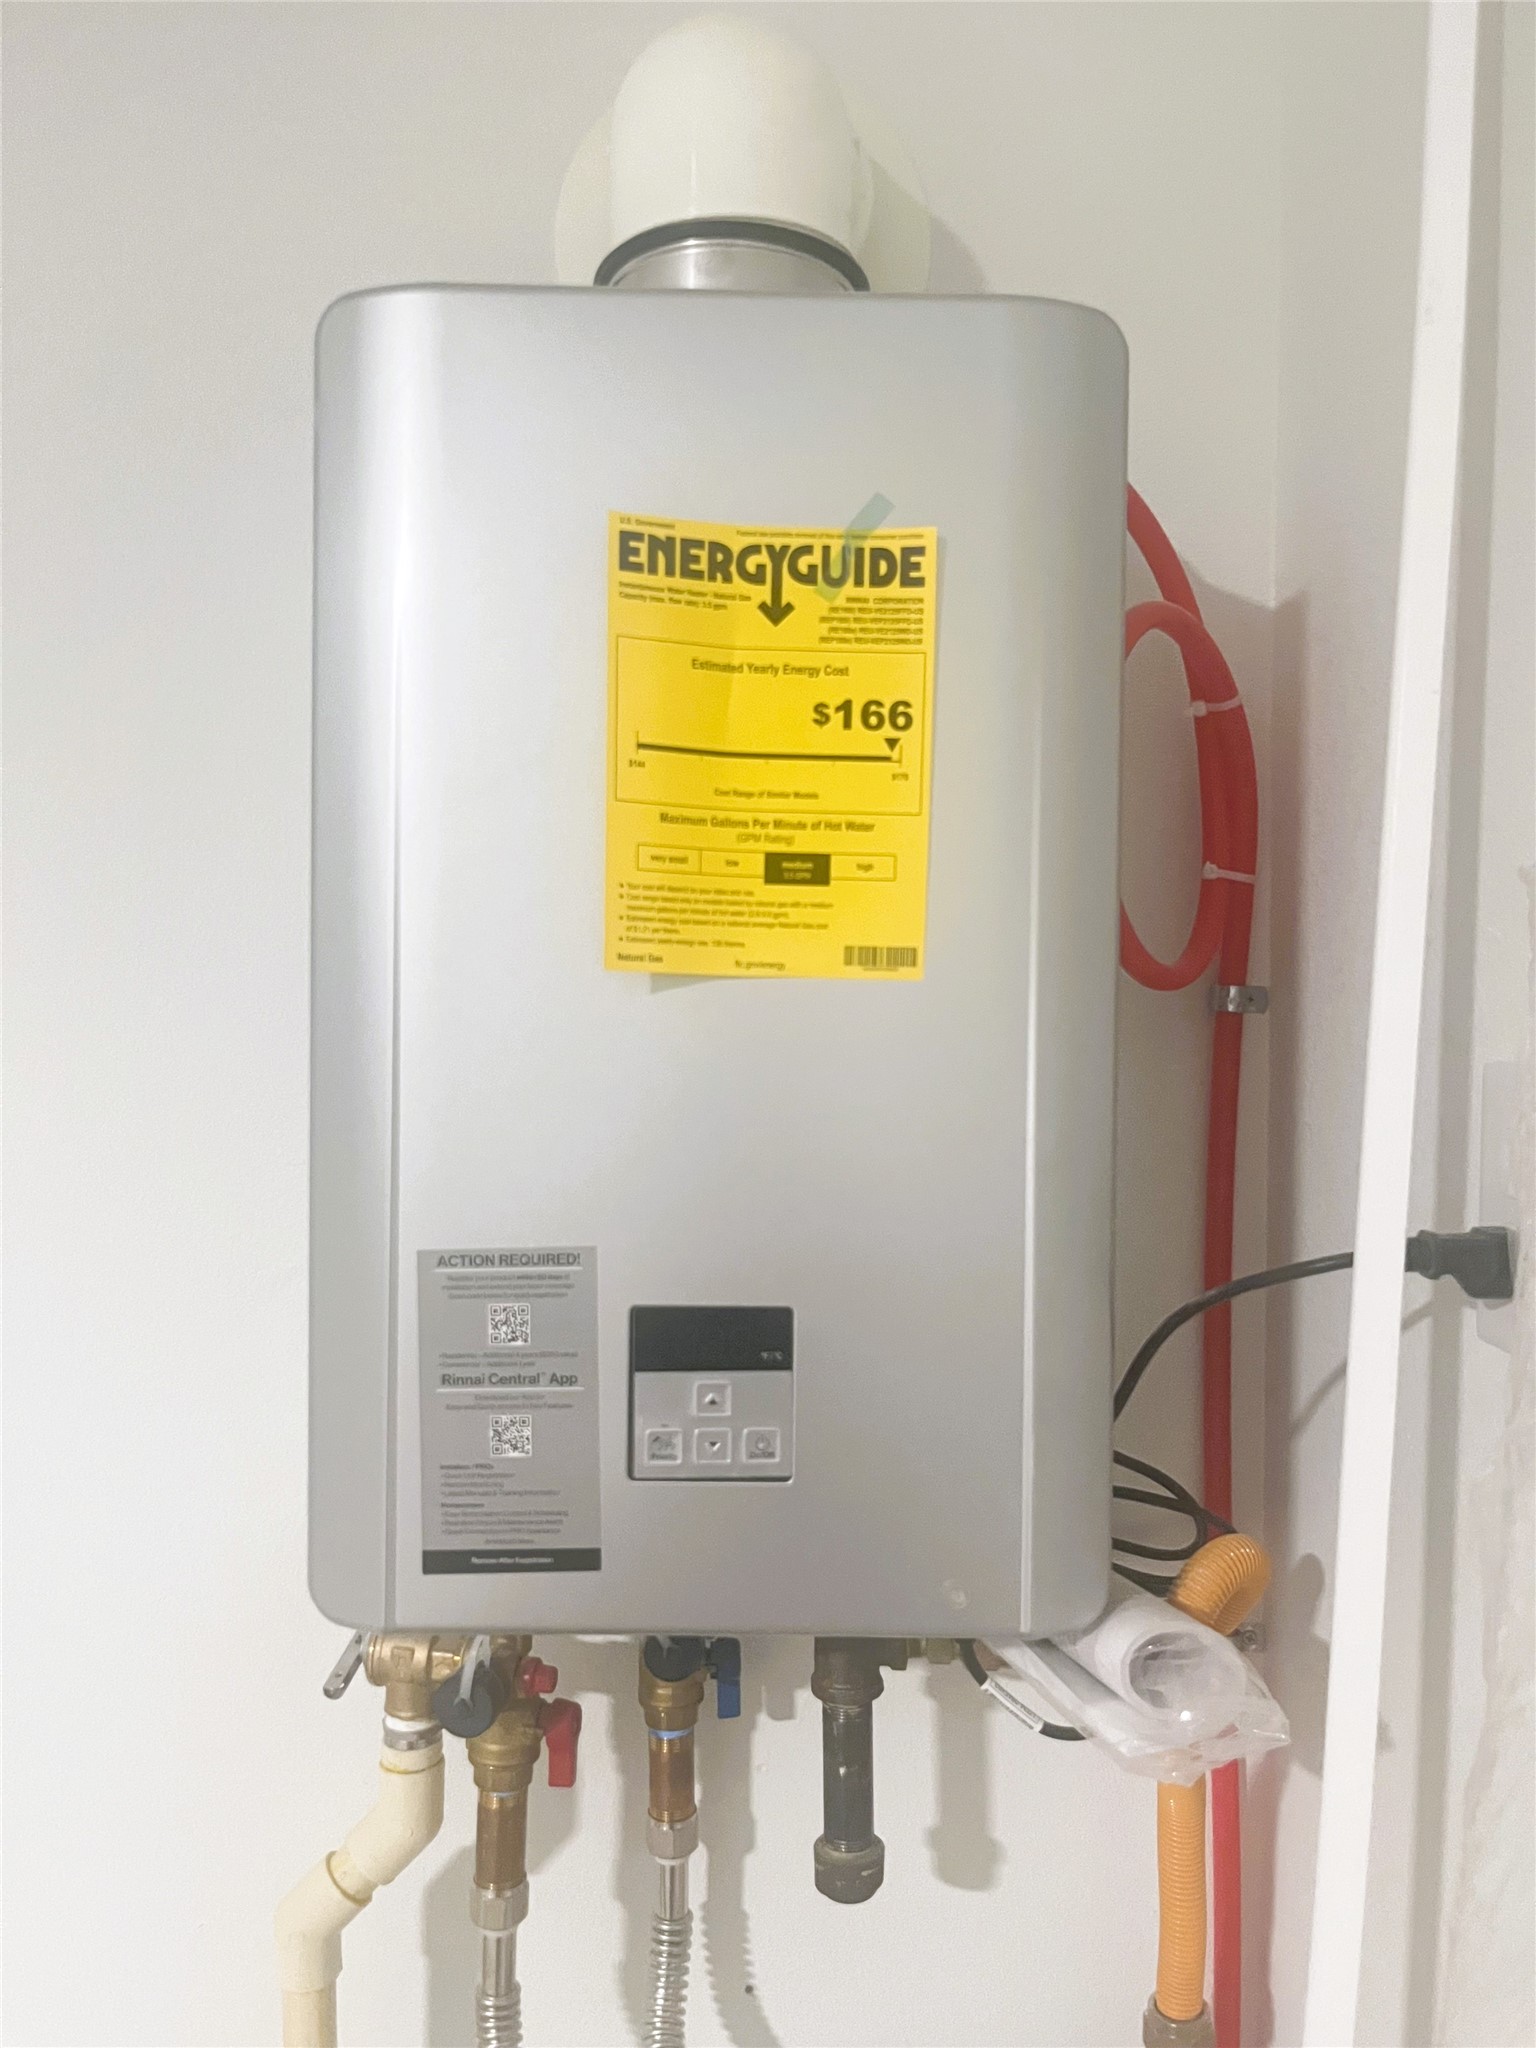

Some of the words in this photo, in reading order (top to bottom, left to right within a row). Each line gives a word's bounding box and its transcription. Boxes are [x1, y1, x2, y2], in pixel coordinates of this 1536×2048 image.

[619, 530, 926, 589] ENERGYGUIDE
[691, 658, 744, 674] Estimated
[746, 662, 780, 678] Yearly
[783, 663, 822, 679] Energy
[823, 665, 850, 677] Cost
[812, 698, 914, 732] $166
[659, 811, 708, 826] Maximum
[710, 816, 750, 829] Gallons
[752, 819, 770, 830] Per
[773, 819, 808, 831] Minute
[810, 820, 822, 831] of
[824, 820, 843, 831] Hot
[845, 821, 875, 832] Water
[617, 952, 646, 962] Natural
[648, 953, 664, 963] Gas
[437, 1254, 496, 1267] ACTION
[500, 1252, 581, 1267] REQUIRED!
[441, 1373, 485, 1386] Rinnai
[549, 1373, 578, 1387] App
